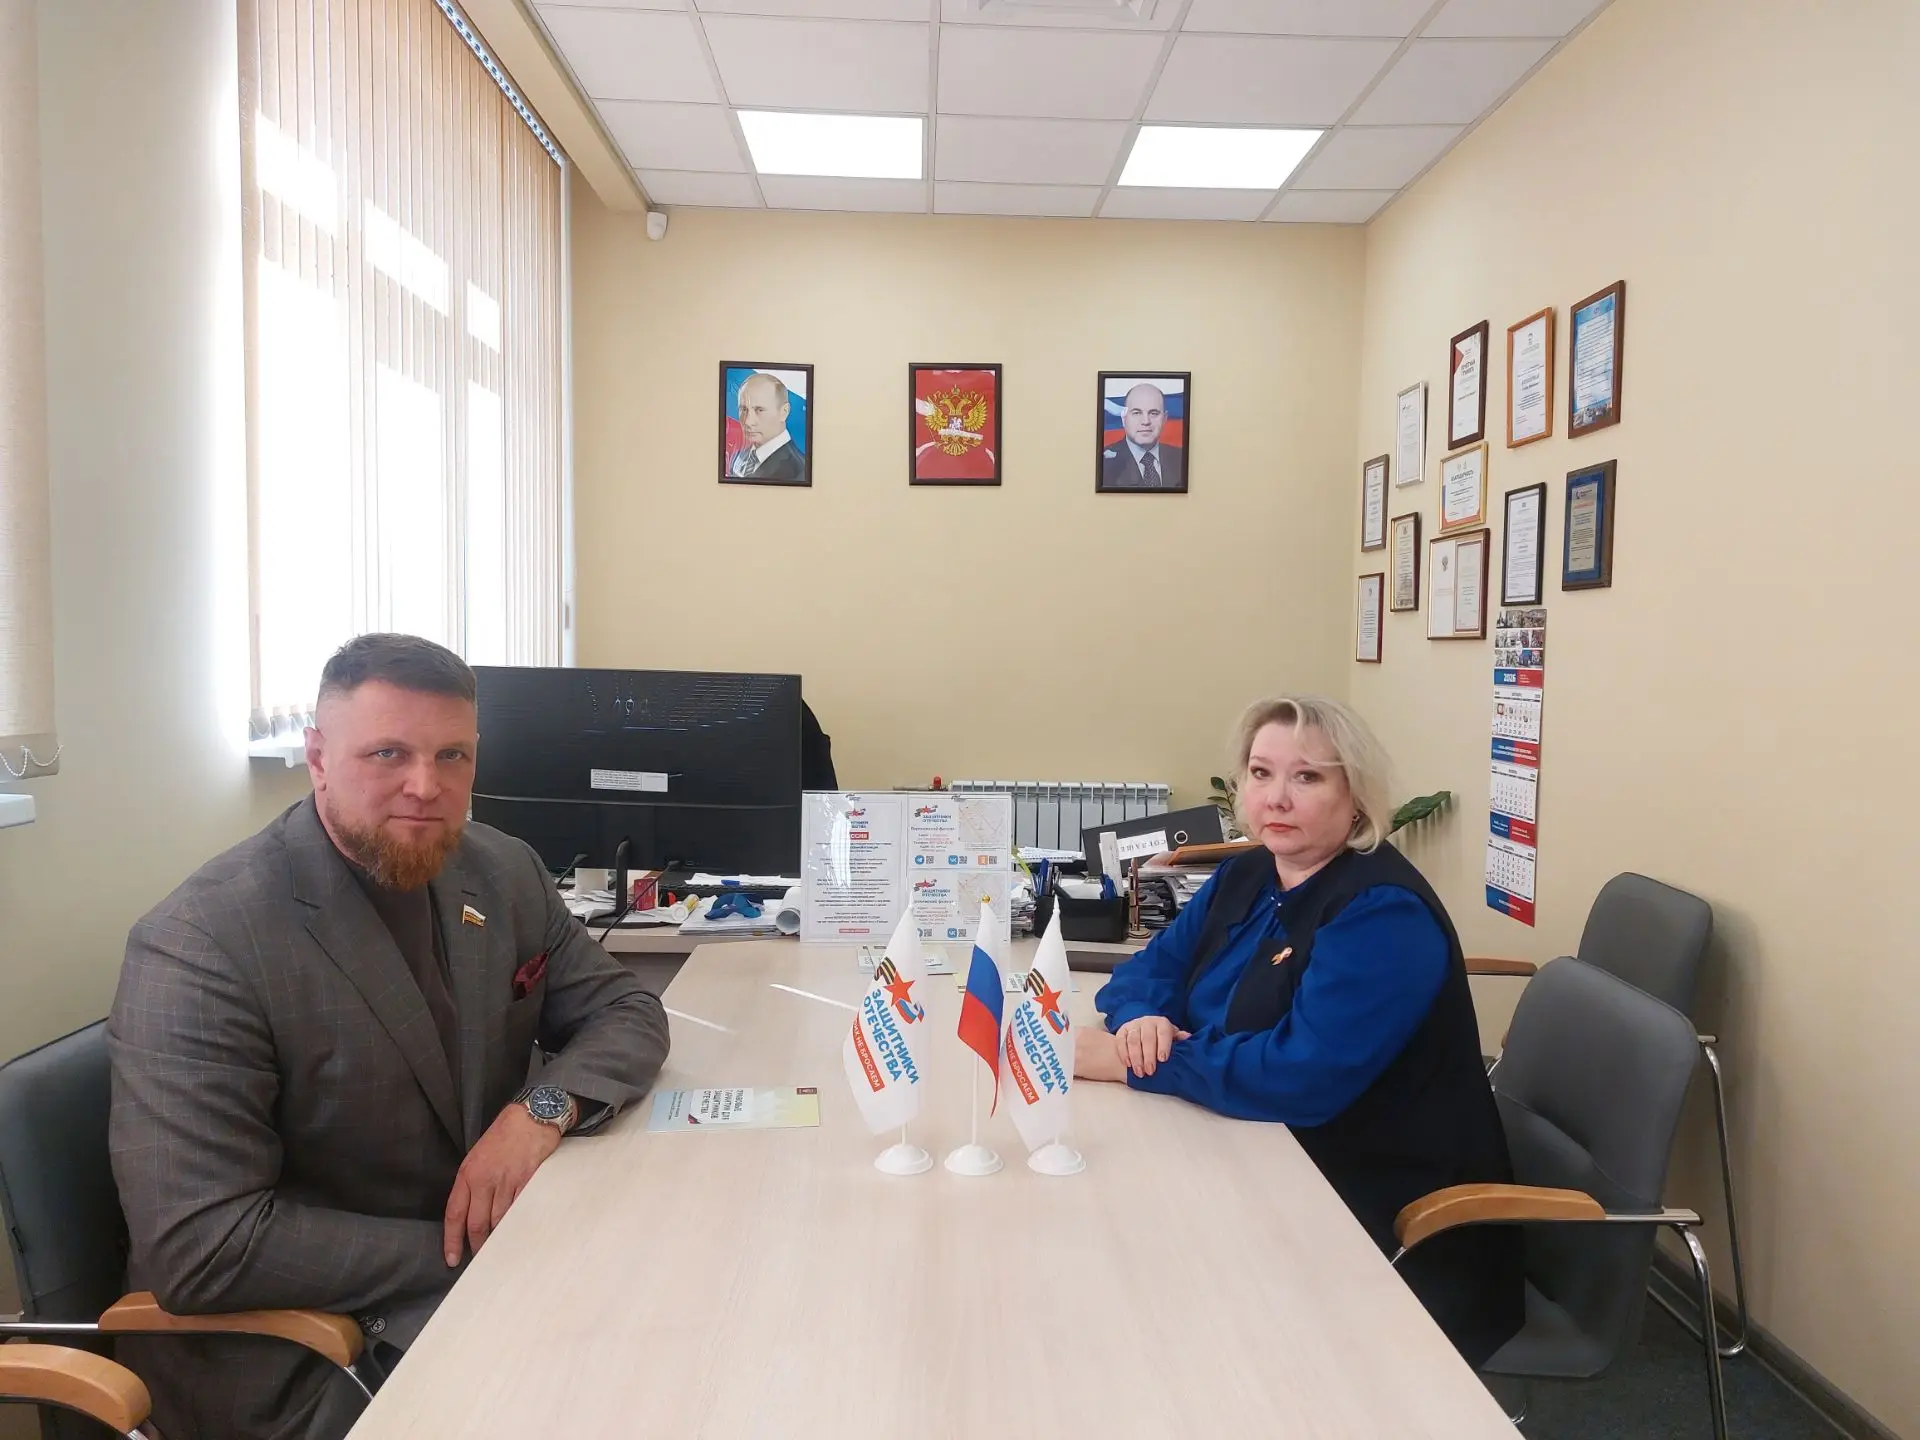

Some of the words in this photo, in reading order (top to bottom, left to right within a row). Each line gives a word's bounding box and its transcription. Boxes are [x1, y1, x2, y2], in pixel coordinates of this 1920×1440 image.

[860, 1048, 881, 1088] БРОСАЕМ
[863, 995, 902, 1082] ОТЕЧЕСТВА
[872, 988, 920, 1084] ЗАЩИТНИКИ
[1014, 1007, 1055, 1094] ОТЕЧЕСТВА
[1022, 1000, 1069, 1095] ЗАЩИТНИКИ
[1011, 1061, 1036, 1100] БРОСАЕМ
